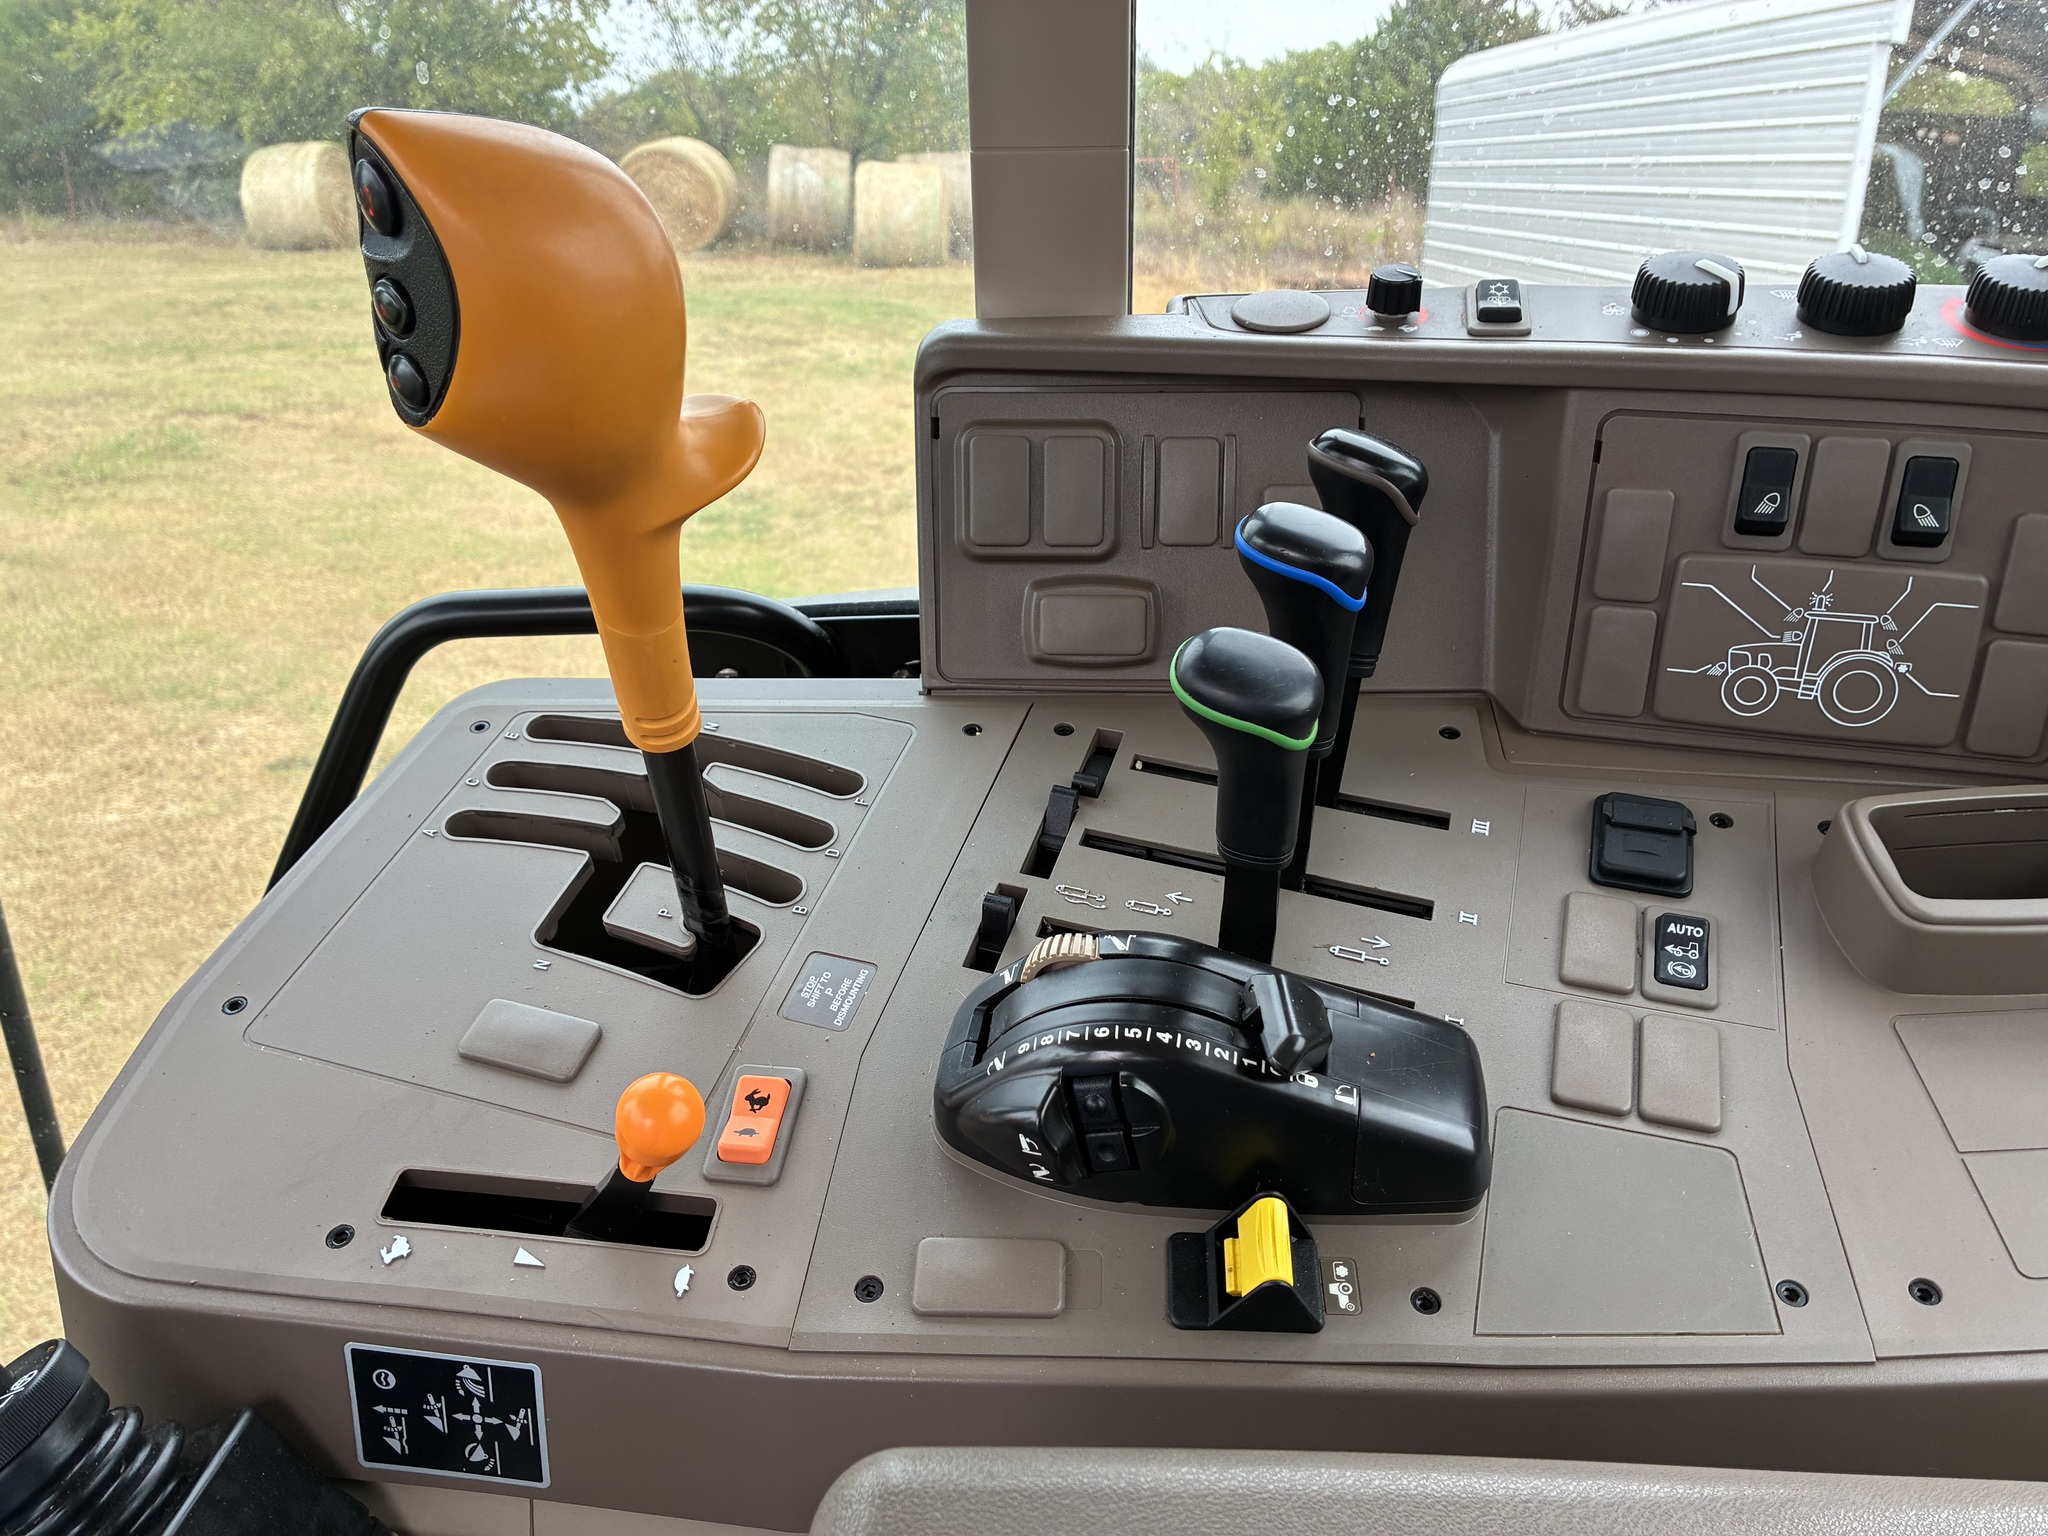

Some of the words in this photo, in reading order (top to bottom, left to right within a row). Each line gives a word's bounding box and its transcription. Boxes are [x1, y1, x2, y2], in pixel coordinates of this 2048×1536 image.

[465, 777, 480, 787] C
[422, 828, 439, 838] A
[824, 848, 840, 858] D
[657, 908, 673, 918] P
[791, 904, 808, 915] B
[1667, 922, 1704, 938] AUTO
[800, 975, 819, 998] STOP
[807, 983, 825, 1008] SHIFT
[820, 971, 832, 983] TO
[825, 987, 834, 997] P
[829, 977, 853, 1012] BEFORE
[833, 968, 869, 1027] DISMOUNTING
[1065, 1030, 1081, 1041] 7
[1094, 1026, 1110, 1038] 6
[1124, 1027, 1142, 1039] 5
[1155, 1031, 1173, 1044] 4
[1040, 1034, 1054, 1046] 8
[1185, 1038, 1202, 1051] 3
[1018, 1042, 1030, 1054] 9
[1214, 1046, 1230, 1060] 2
[1241, 1056, 1258, 1067] 1
